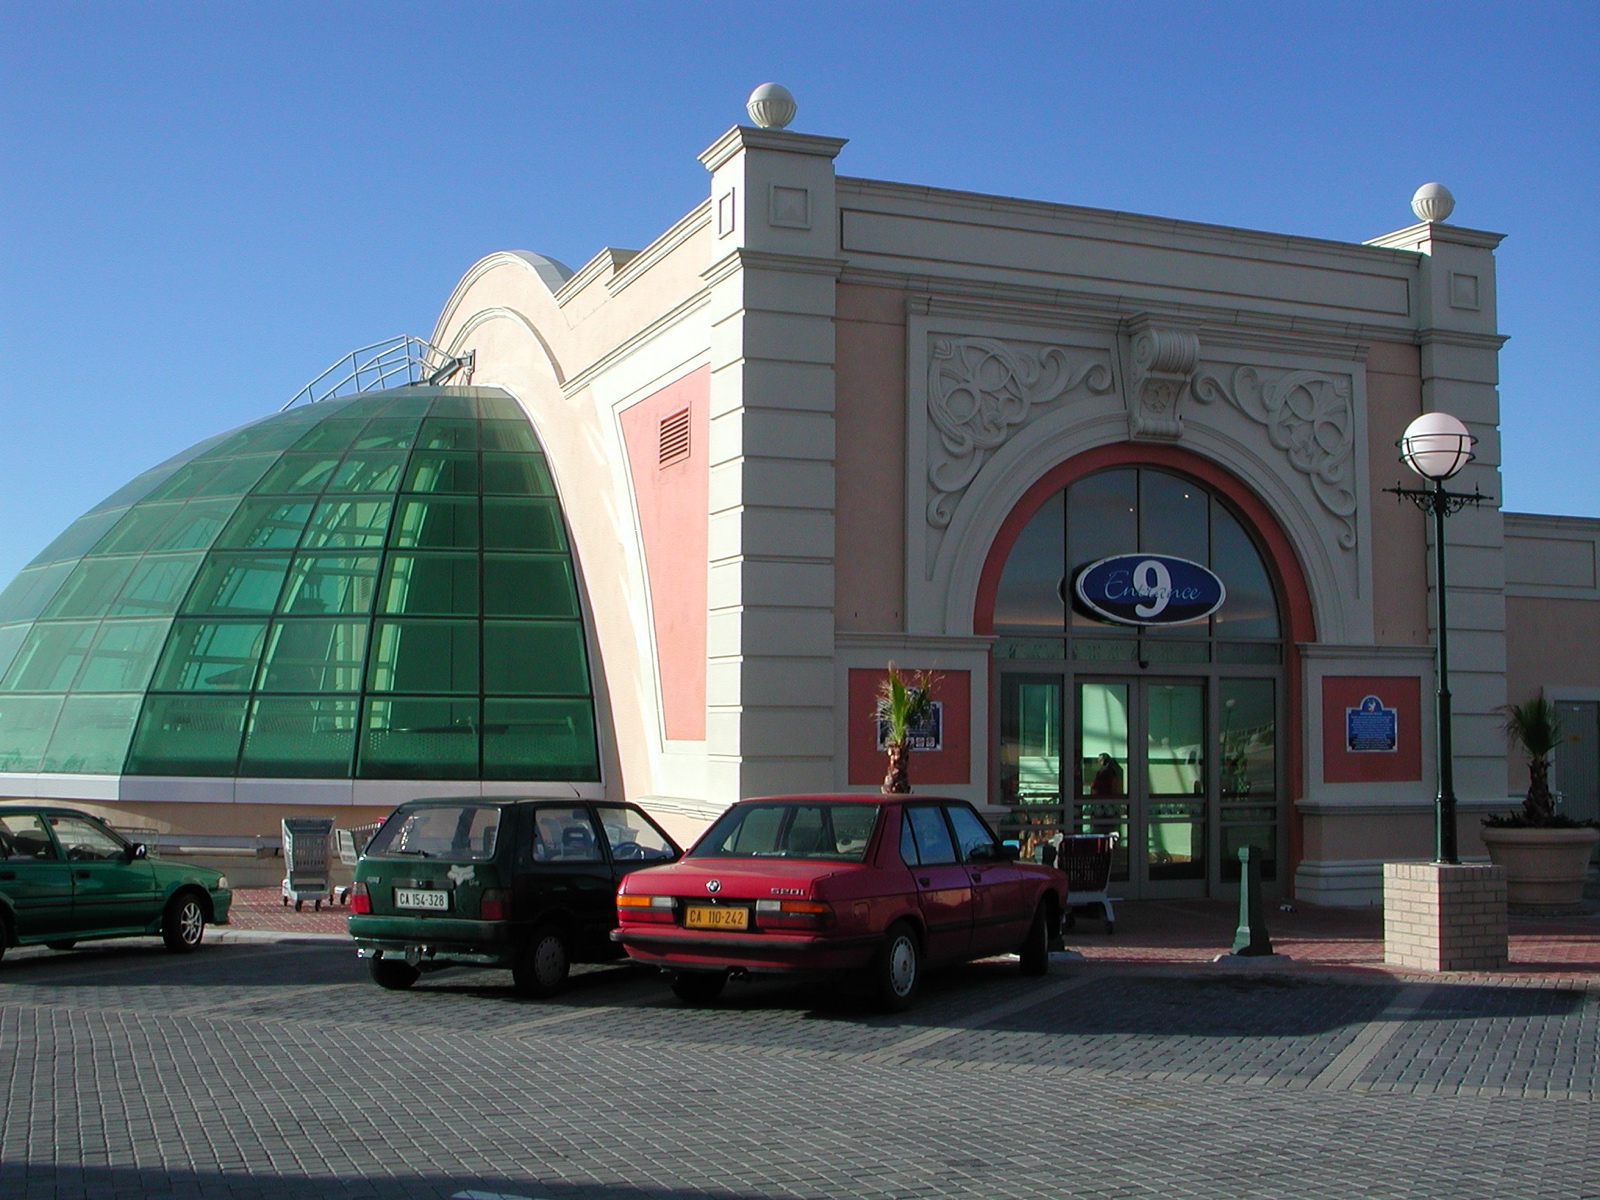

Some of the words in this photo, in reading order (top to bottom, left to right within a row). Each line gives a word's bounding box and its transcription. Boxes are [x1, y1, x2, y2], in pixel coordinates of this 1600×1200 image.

[1104, 570, 1201, 600] Entrance
[1133, 560, 1172, 618] 9
[399, 893, 410, 906] CA
[412, 893, 444, 906] 154-328
[689, 910, 701, 923] CA
[708, 910, 743, 925] 110-242
